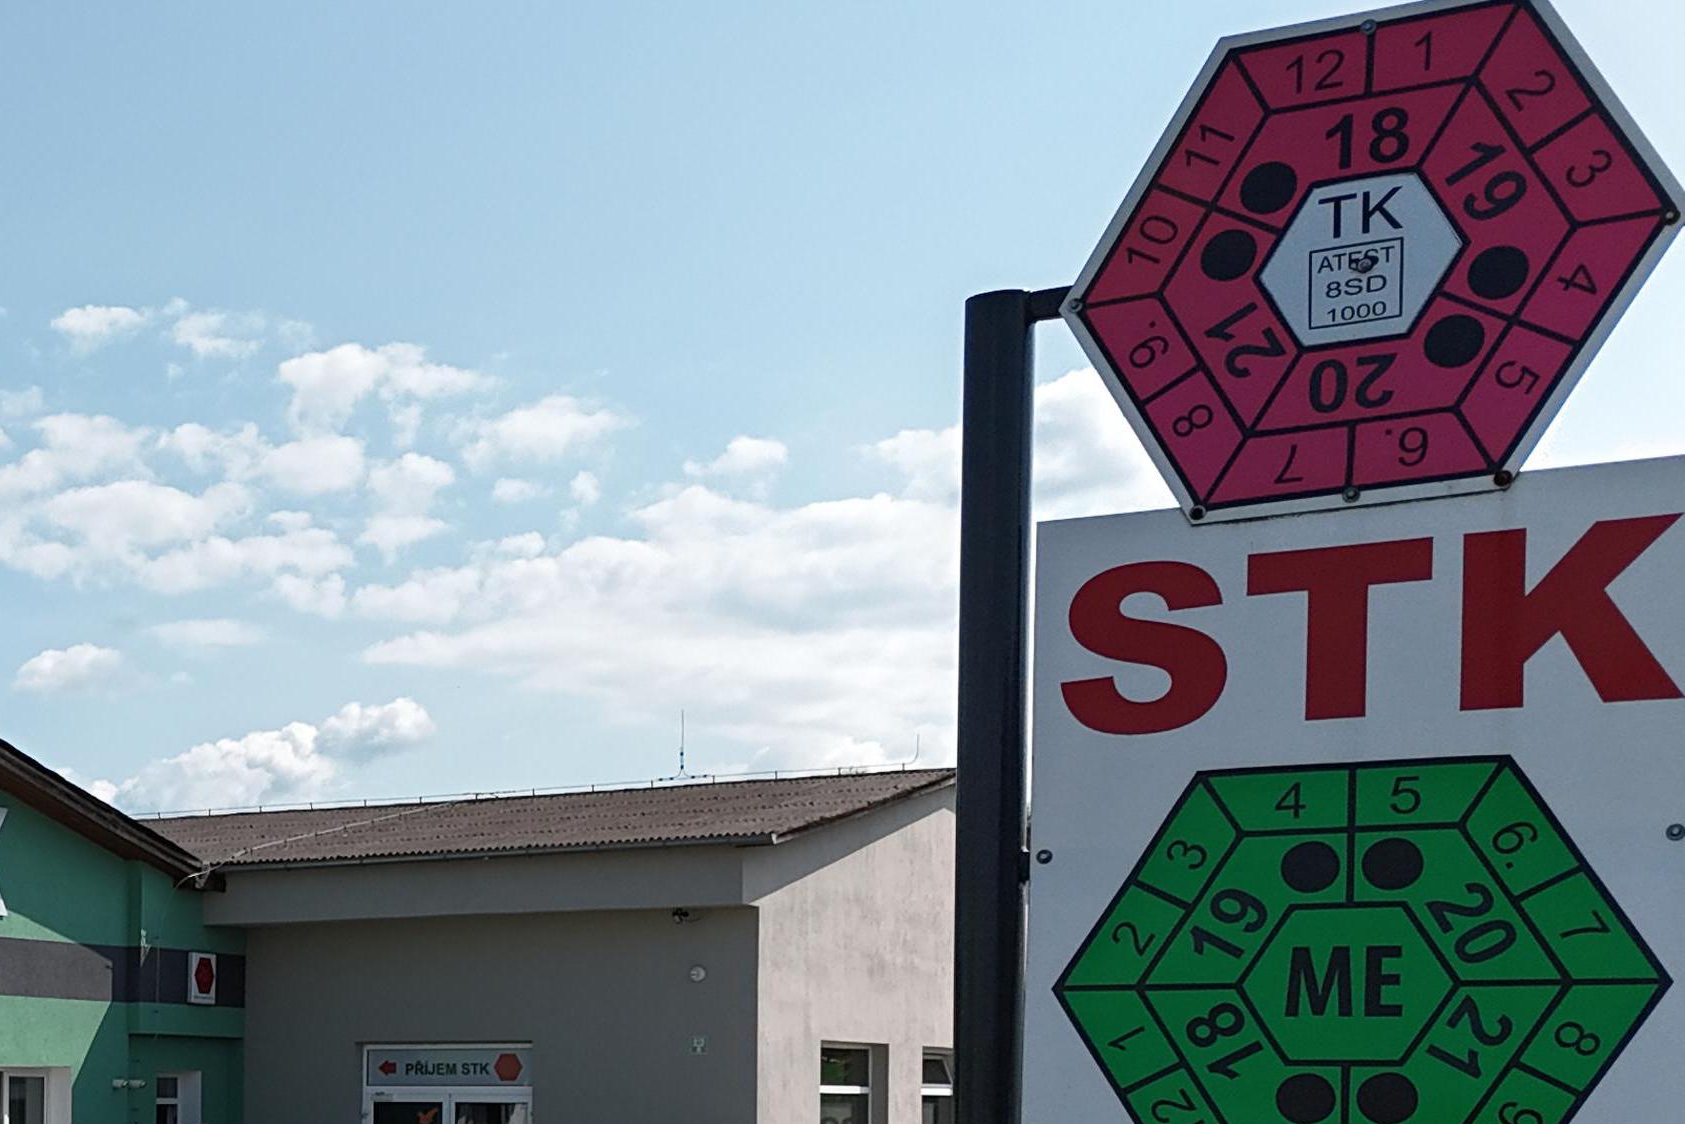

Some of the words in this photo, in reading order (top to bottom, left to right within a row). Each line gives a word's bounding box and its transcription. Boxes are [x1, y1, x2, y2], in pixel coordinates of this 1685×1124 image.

[1287, 49, 1344, 94] 12
[1414, 32, 1434, 70] 1
[1506, 69, 1556, 110] 2
[1184, 123, 1235, 170] 11
[1324, 106, 1410, 169] 18
[1445, 141, 1527, 220] 19
[1566, 149, 1612, 188] 3
[1318, 186, 1403, 238] TK
[1127, 215, 1179, 268] 10
[1326, 275, 1387, 298] 8SD
[1557, 263, 1598, 297] 4
[1327, 301, 1386, 322] 1000
[1205, 302, 1287, 378] 21
[1308, 352, 1398, 412] 20
[1495, 360, 1541, 395] 5
[1172, 403, 1213, 437] 8
[1273, 443, 1299, 484] 7
[1060, 513, 1685, 736] STK
[1275, 782, 1306, 819] 4
[1390, 775, 1421, 815] 5
[1166, 839, 1207, 871] 3
[1111, 921, 1156, 957] 2
[1192, 888, 1269, 960] 19
[1425, 883, 1518, 965] 20
[1560, 909, 1611, 939] 7
[1284, 944, 1404, 1019] ME
[1106, 1024, 1146, 1053] 1
[1185, 1002, 1265, 1081] 18
[1426, 994, 1513, 1081] 21
[1554, 1021, 1601, 1057] 8
[405, 1060, 458, 1076] PŘÍJEM
[461, 1062, 490, 1076] STK
